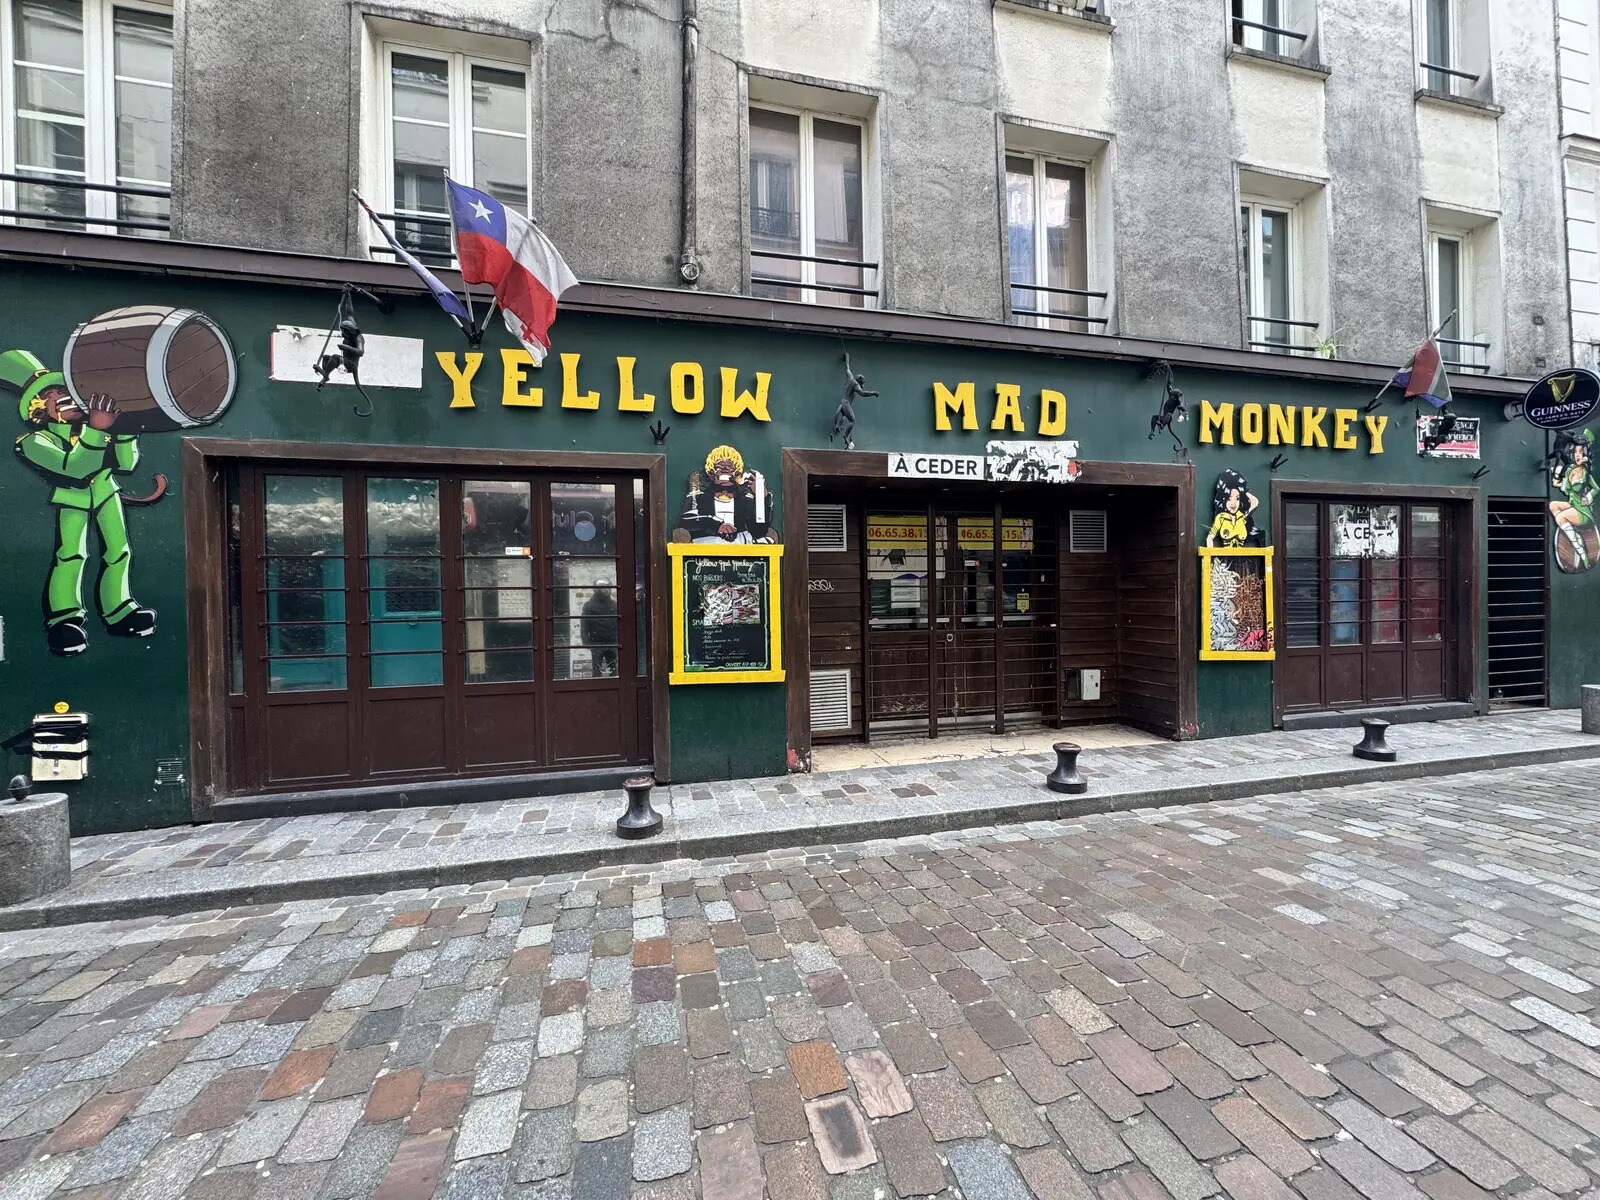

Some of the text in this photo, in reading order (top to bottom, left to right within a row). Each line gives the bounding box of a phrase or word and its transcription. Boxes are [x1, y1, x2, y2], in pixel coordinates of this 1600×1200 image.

[435, 348, 1388, 454] YELLOW MAD MONKEY
[1530, 399, 1592, 418] GUINNESS
[894, 453, 909, 473] À
[915, 458, 978, 475] CEDER
